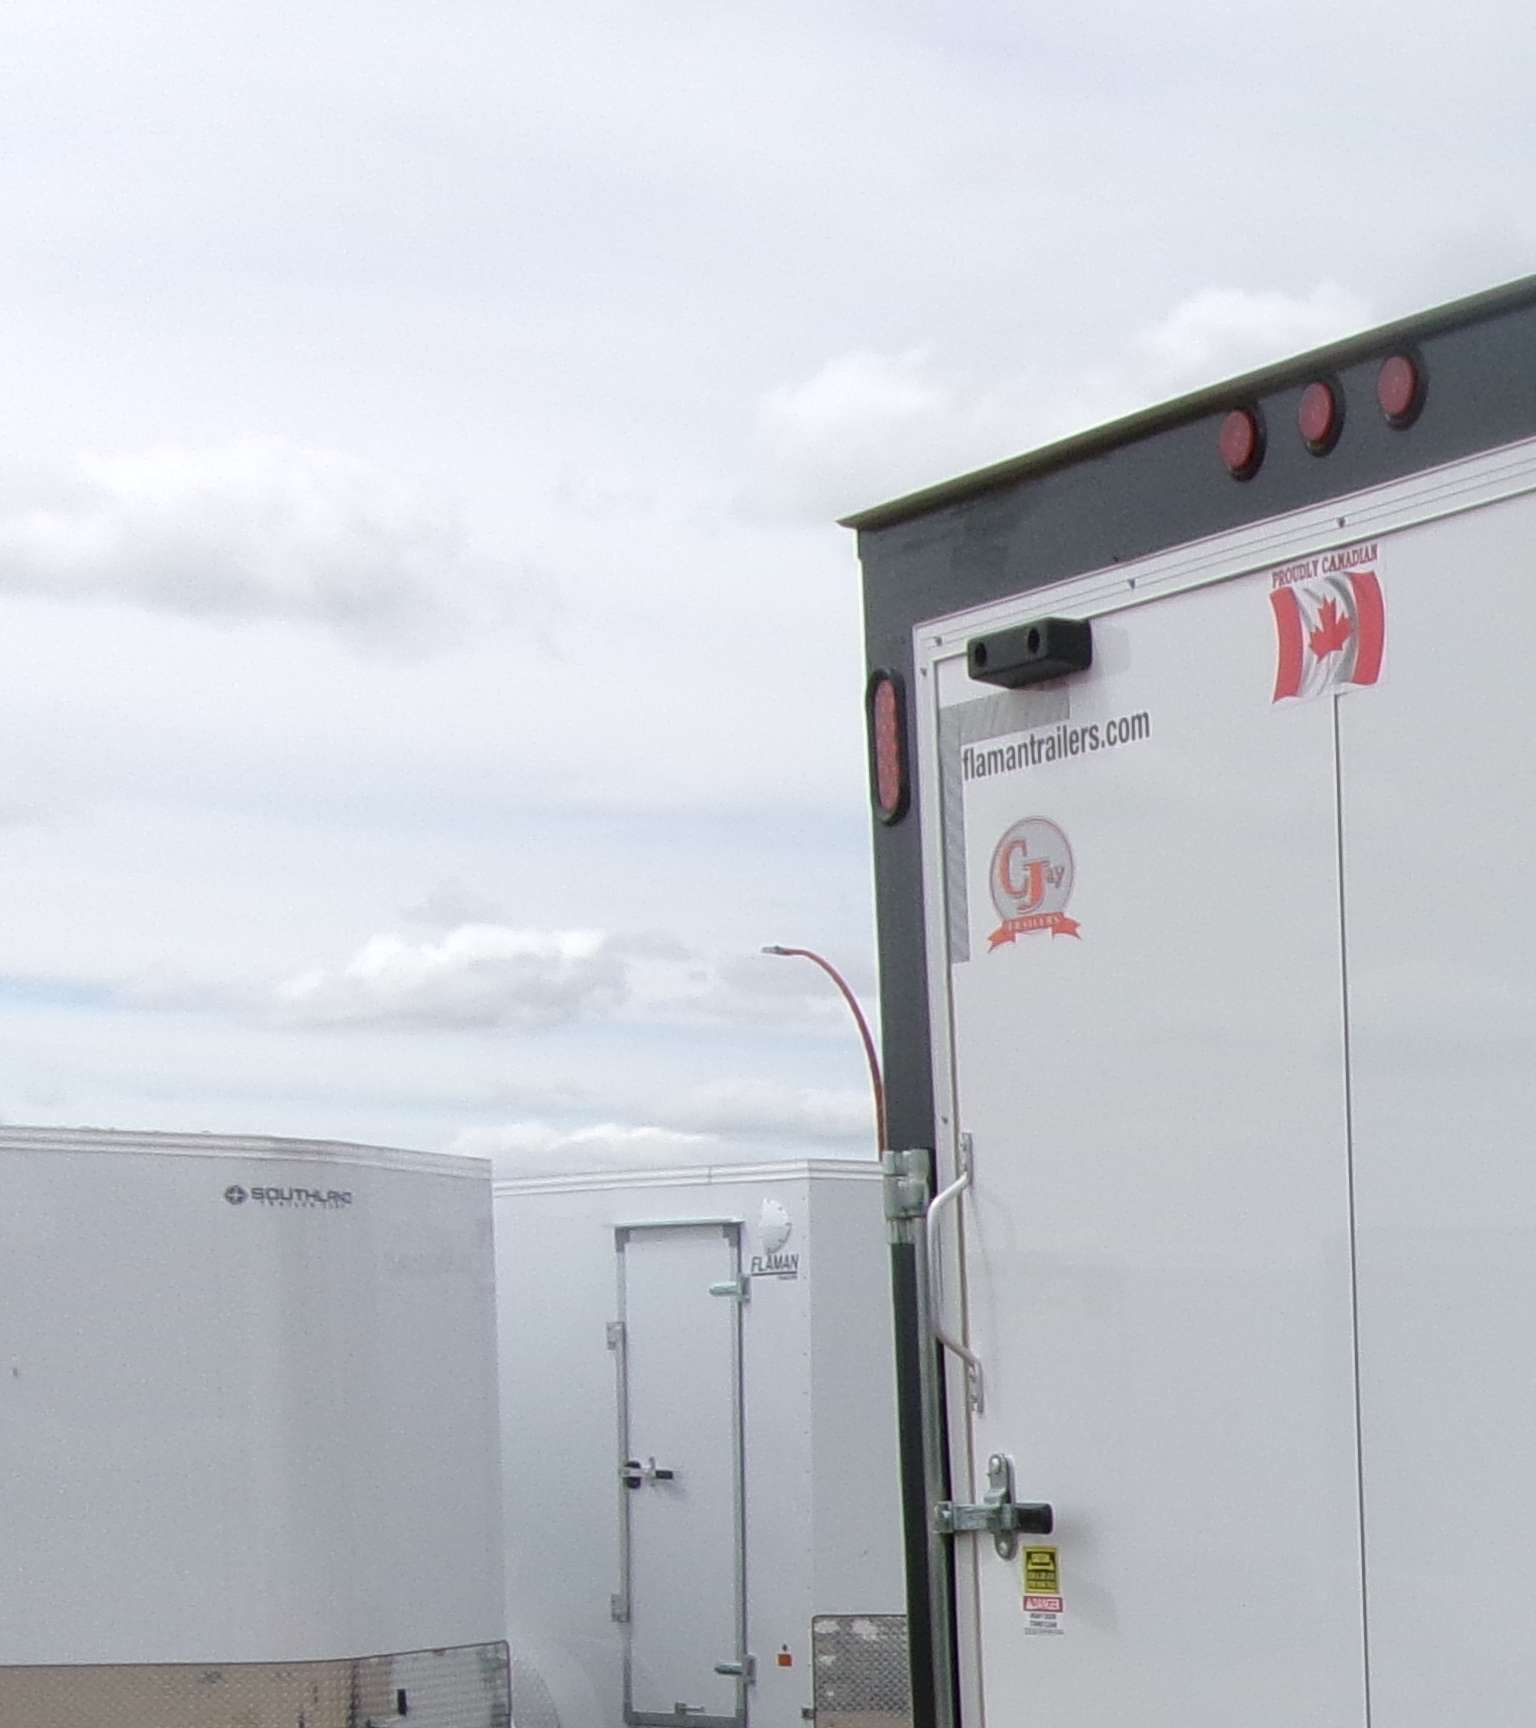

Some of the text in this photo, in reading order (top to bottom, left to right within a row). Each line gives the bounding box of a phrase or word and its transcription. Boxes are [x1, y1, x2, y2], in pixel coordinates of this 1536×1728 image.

[1272, 543, 1378, 589] PROUDLY CANADIAN
[962, 711, 1151, 781] flamantrailers.com
[750, 1253, 799, 1273] FLAMAN
